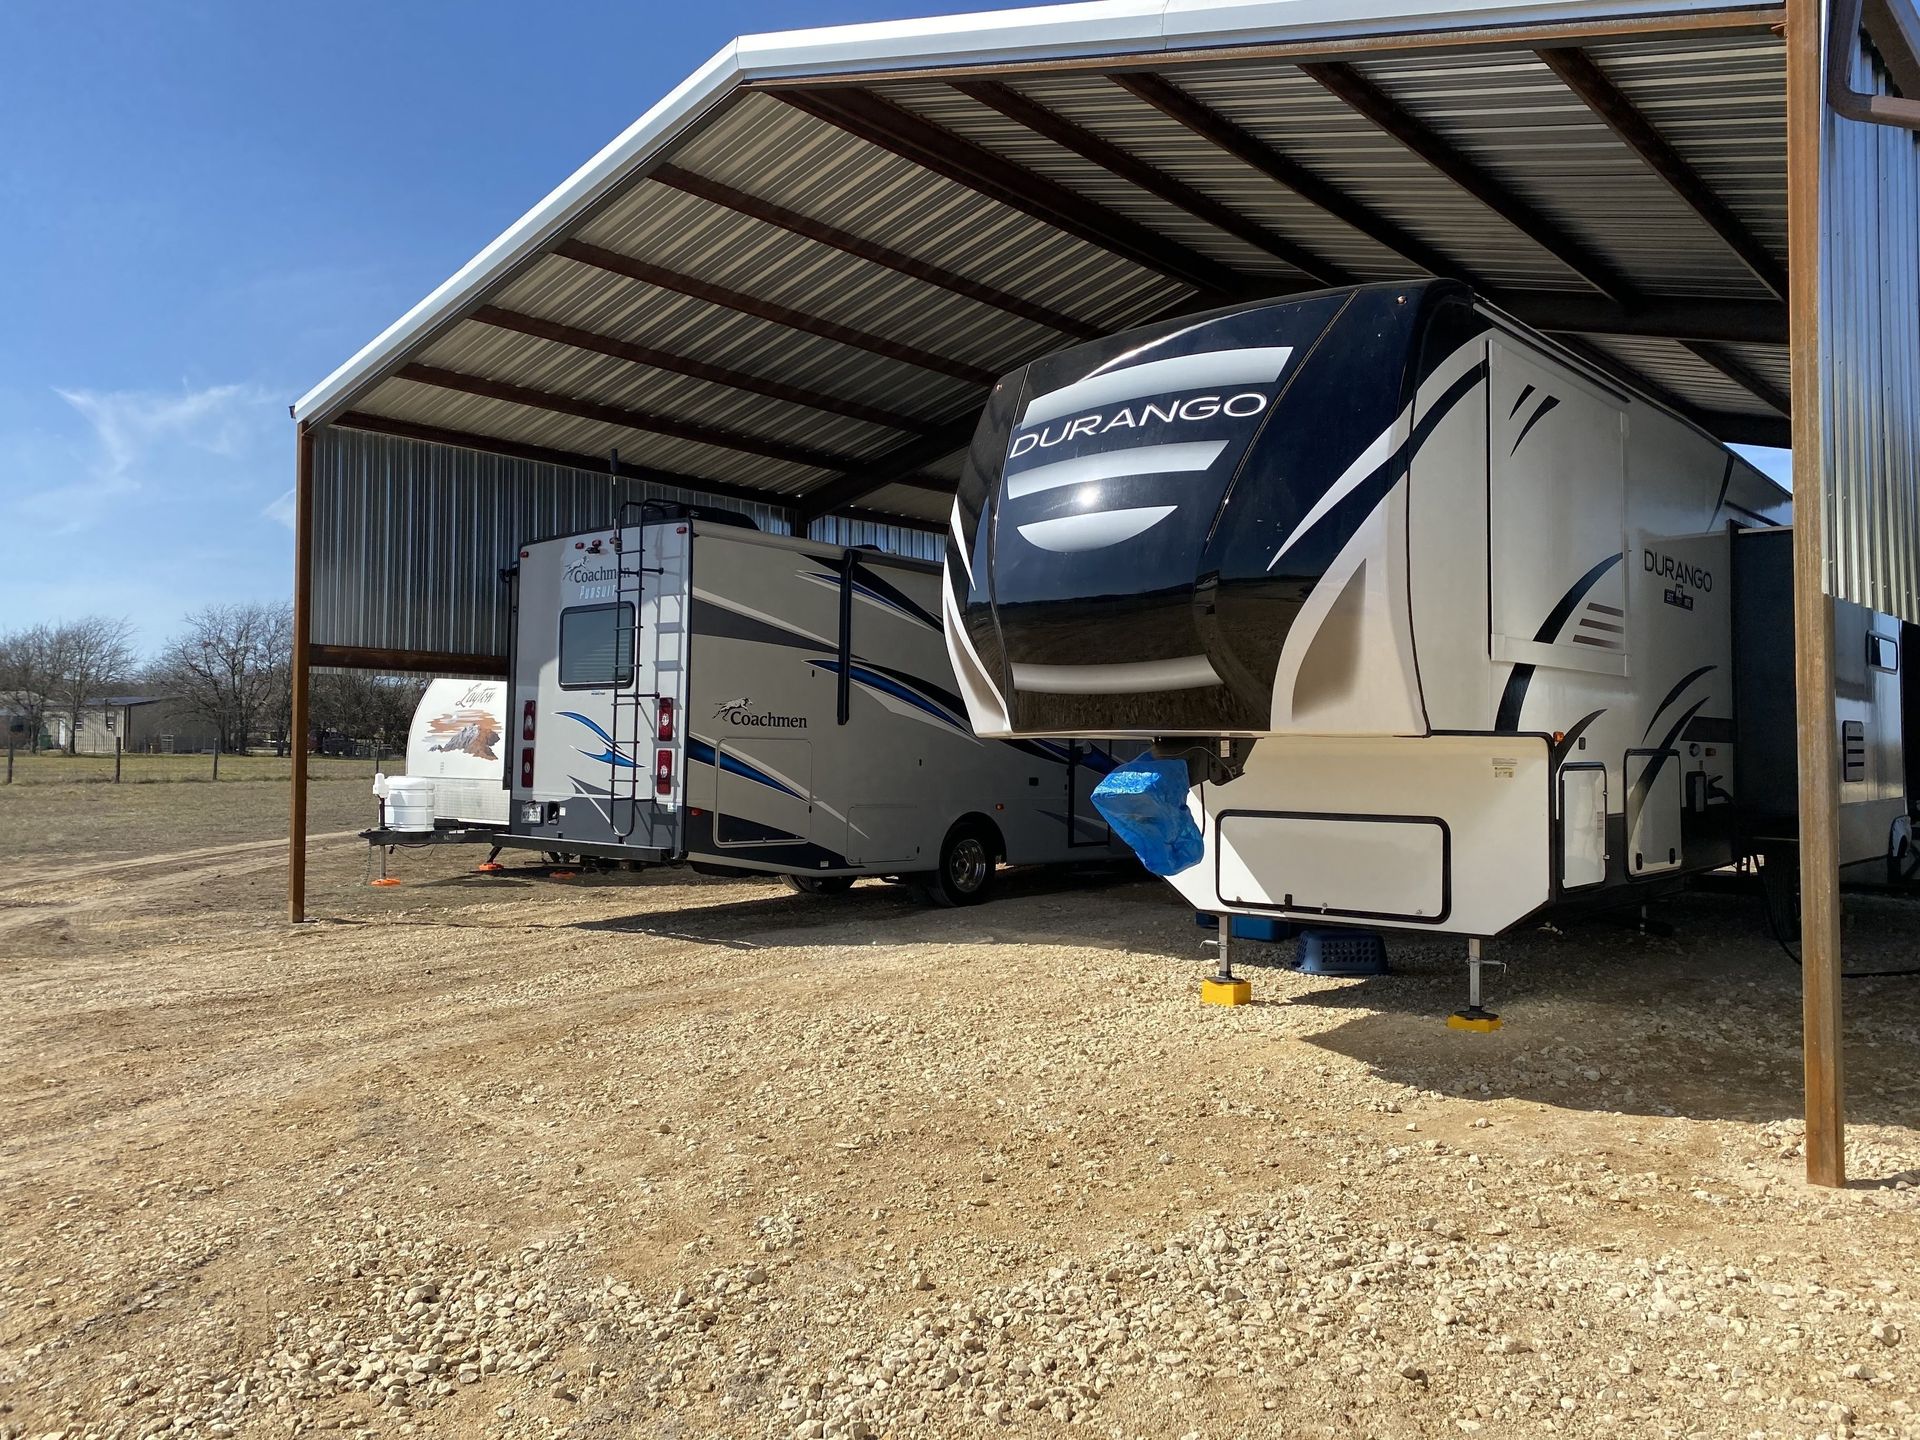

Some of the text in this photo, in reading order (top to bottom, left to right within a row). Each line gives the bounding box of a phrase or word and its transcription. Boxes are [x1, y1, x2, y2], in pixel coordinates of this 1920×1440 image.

[1009, 392, 1268, 460] DURANGO
[1644, 549, 1712, 593] DURANGO
[730, 711, 807, 728] Coachmen
